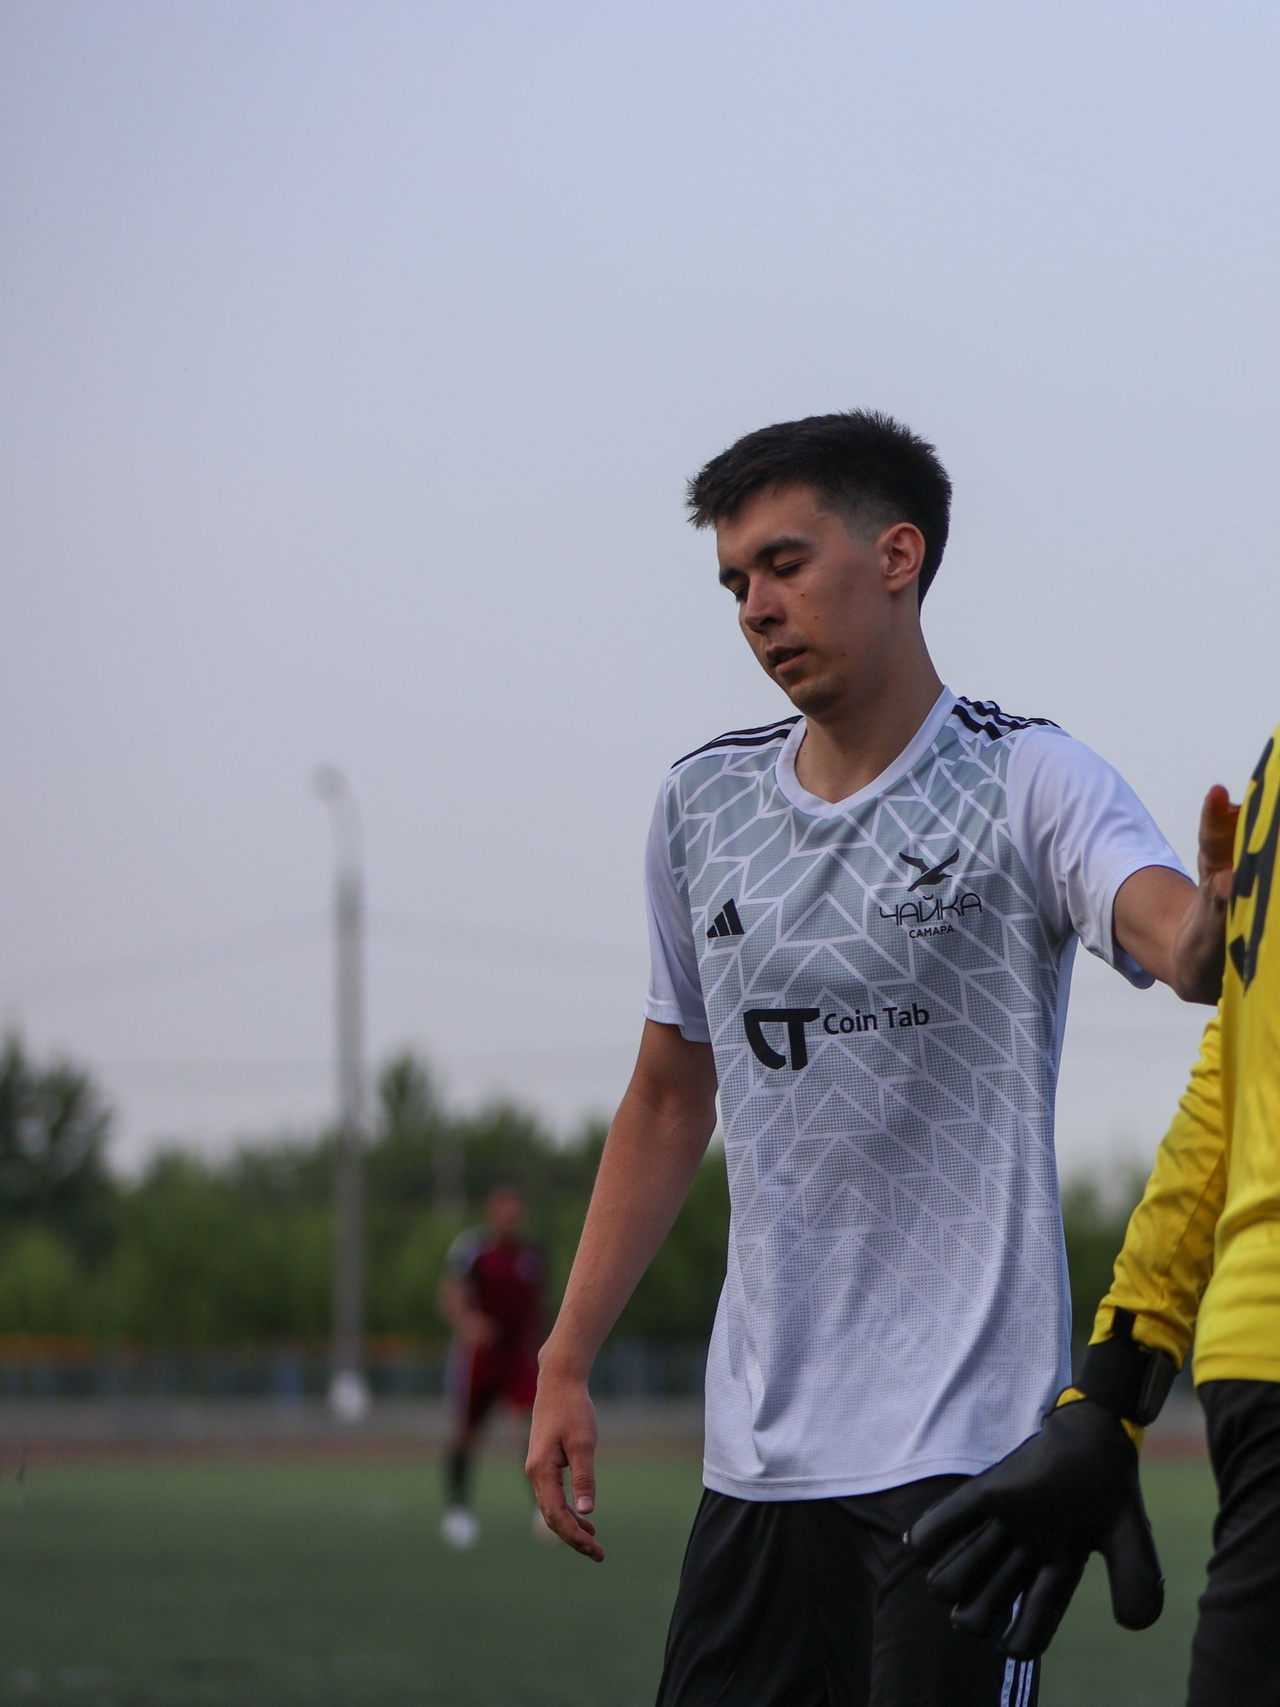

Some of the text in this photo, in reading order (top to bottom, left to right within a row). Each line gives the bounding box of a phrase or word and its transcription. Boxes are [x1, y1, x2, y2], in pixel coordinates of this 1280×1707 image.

[879, 892, 983, 926] ЧАЙКА
[908, 924, 956, 939] САМАРА
[823, 1008, 878, 1035] Coin
[882, 1002, 930, 1029] Tab
